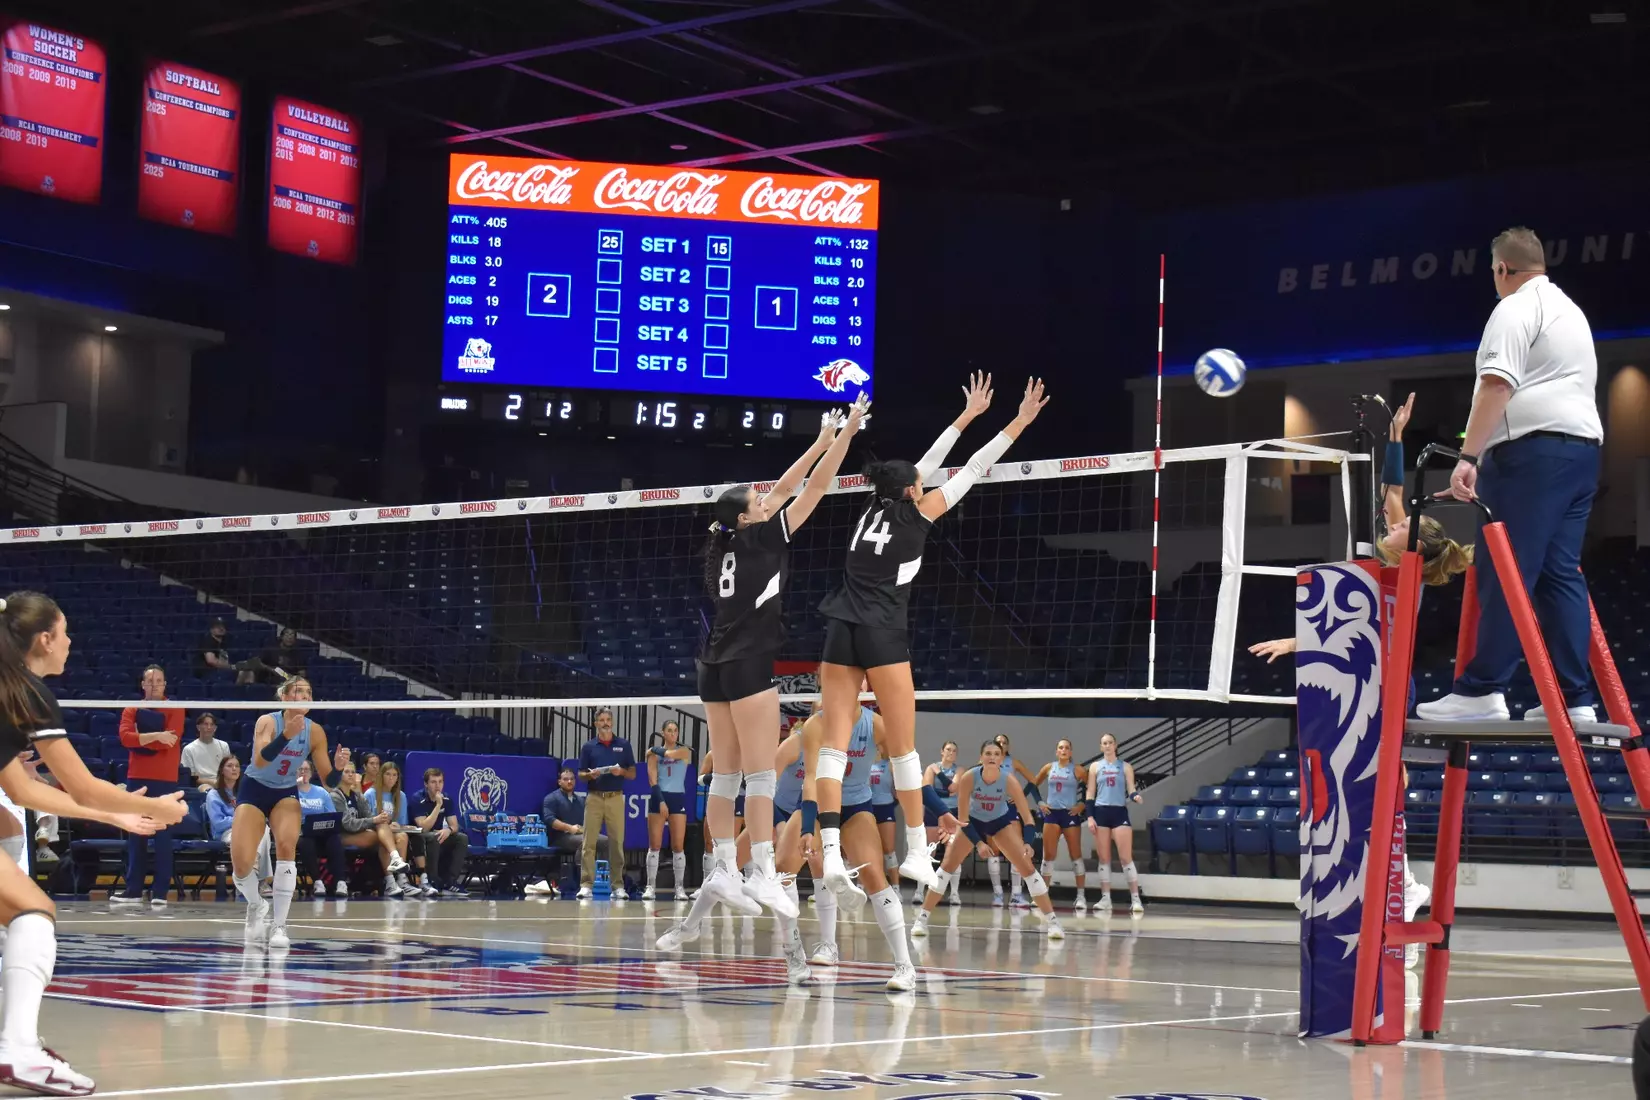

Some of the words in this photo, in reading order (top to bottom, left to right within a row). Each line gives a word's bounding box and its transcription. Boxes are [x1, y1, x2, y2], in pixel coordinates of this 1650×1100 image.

[29, 25, 84, 50] WOMEN'S
[34, 41, 77, 62] SOCCER
[11, 50, 54, 70] CONFERENCE
[56, 63, 94, 80] CHAMPIONS
[2, 62, 24, 76] 2008
[55, 76, 76, 90] 2019
[165, 70, 220, 94] SOFTBALL
[146, 102, 166, 116] 2025
[155, 91, 193, 108] CONFERENCE
[195, 102, 230, 118] CHAMPIONS
[288, 104, 350, 132] VOLLEYBALL
[18, 119, 35, 131] NCAA
[39, 124, 82, 143] TOURNAMENT
[26, 134, 47, 147] 2019
[284, 128, 318, 143] CONFERENCE
[320, 138, 352, 153] CHAMPIONS
[144, 164, 164, 178] 2025
[160, 157, 176, 169] NCAA
[179, 162, 219, 178] TOURNAMENT
[456, 161, 580, 205] Coca-Cola
[594, 168, 728, 216] Coca-Cola
[740, 176, 871, 224] Coca-Cola
[305, 193, 342, 209] TOURNAMENT
[317, 206, 334, 220] 2012
[452, 215, 479, 225] ATT%
[483, 217, 507, 229] .405
[451, 235, 478, 245] KILLS
[488, 236, 501, 248] 18
[602, 236, 619, 249] 25
[641, 238, 677, 253] SET
[683, 239, 690, 253] 1
[712, 243, 727, 255] 15
[814, 236, 842, 246] ATT%
[845, 239, 868, 250] .132
[450, 255, 476, 265] BLKS
[485, 256, 502, 268] 3.0
[814, 256, 842, 266] KILLS
[850, 258, 863, 269] 10
[640, 268, 676, 282] SET
[679, 269, 690, 283] 2
[1278, 248, 1477, 293] BELMON
[449, 275, 476, 285] ACES
[489, 276, 496, 287] 2
[814, 276, 839, 286] BLKS
[847, 277, 864, 288] 2.0
[448, 295, 472, 306] DIGS
[485, 296, 499, 307] 19
[543, 284, 556, 304] 2
[813, 295, 839, 305] ACES
[853, 297, 858, 307] 1
[639, 297, 675, 312] SET
[678, 298, 689, 312] 3
[772, 298, 780, 315] 1
[447, 315, 473, 325] ASTS
[484, 315, 498, 326] 17
[812, 315, 836, 326] DIGS
[848, 315, 862, 327] 13
[638, 326, 674, 341] SET
[678, 328, 688, 342] 4
[812, 335, 837, 346] ASTS
[848, 335, 861, 346] 10
[637, 356, 673, 370] SET
[676, 357, 687, 371] 5
[506, 395, 522, 420] 2
[546, 403, 551, 417] 1
[560, 403, 572, 419] 2
[636, 402, 676, 428] 1:15
[694, 413, 705, 429] 2
[743, 412, 753, 429] 2
[772, 413, 783, 430] 0
[12, 528, 40, 538] BRUINS
[80, 525, 107, 535] BELMONT
[148, 521, 179, 532] BRUINS
[222, 517, 251, 528] BELMONT
[297, 512, 330, 524] BRUINS
[378, 507, 411, 519] BELMONT
[460, 502, 497, 514] BRUINS
[549, 496, 585, 508] BELMONT
[639, 489, 680, 502] BRUINS
[1060, 456, 1110, 472] BRUINS
[851, 504, 892, 556] 14
[719, 552, 737, 597] 8
[277, 760, 291, 776] 3
[667, 766, 672, 777] 1
[1107, 777, 1115, 786] 15
[1384, 813, 1404, 958] BELMOT
[765, 1069, 1046, 1091] BYRD
